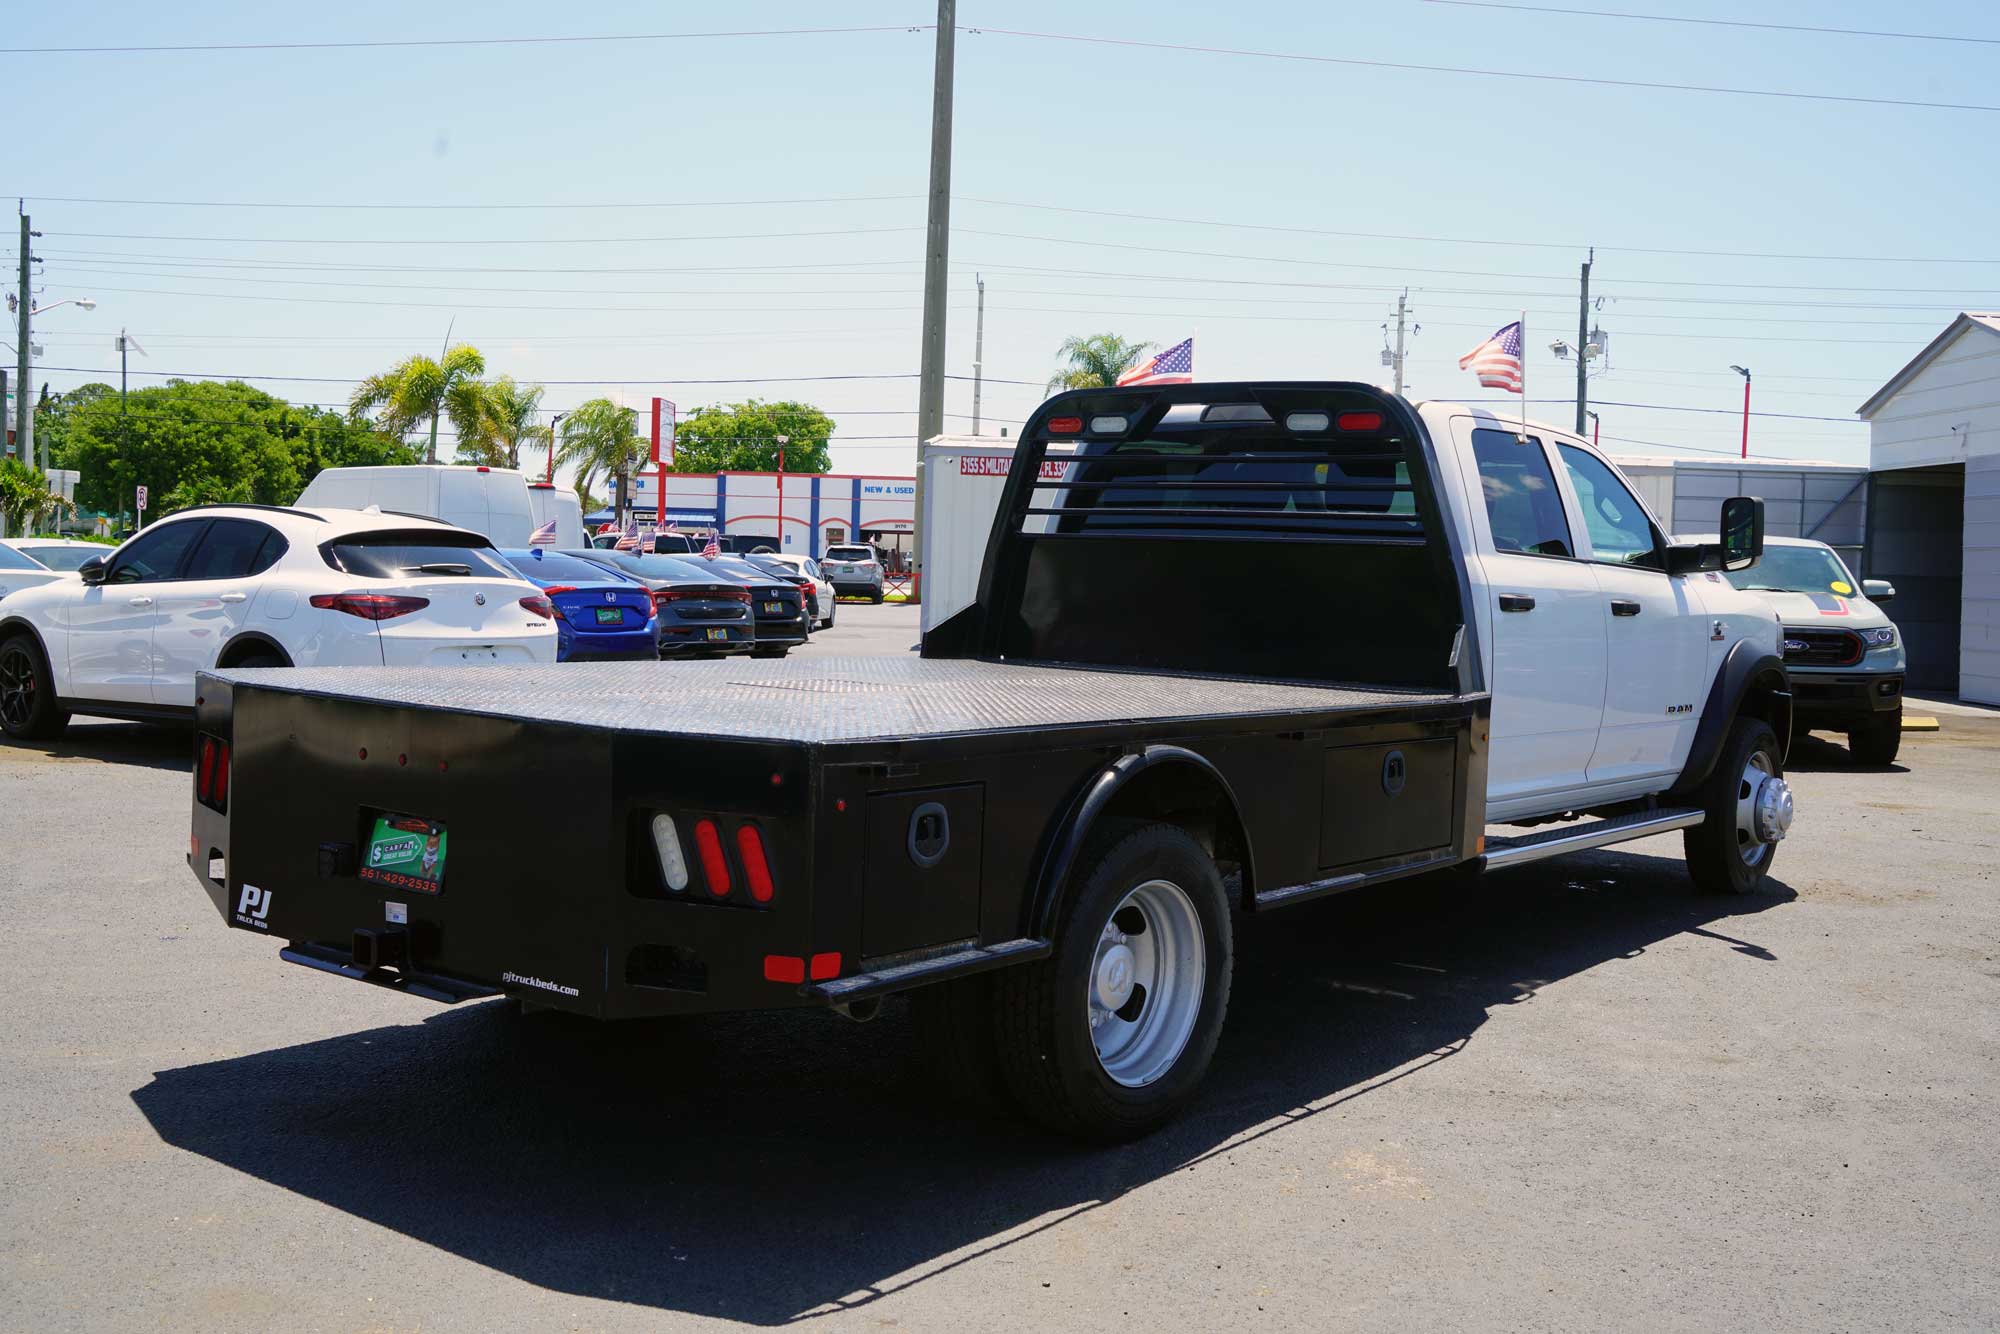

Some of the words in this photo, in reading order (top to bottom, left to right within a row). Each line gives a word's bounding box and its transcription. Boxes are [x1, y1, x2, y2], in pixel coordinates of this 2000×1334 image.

[961, 457, 979, 473] 3155
[979, 458, 985, 473] S
[886, 486, 892, 494] &
[1666, 704, 1693, 713] RAM
[238, 883, 272, 919] PJ
[502, 971, 579, 997] pjtruckbeds.com
